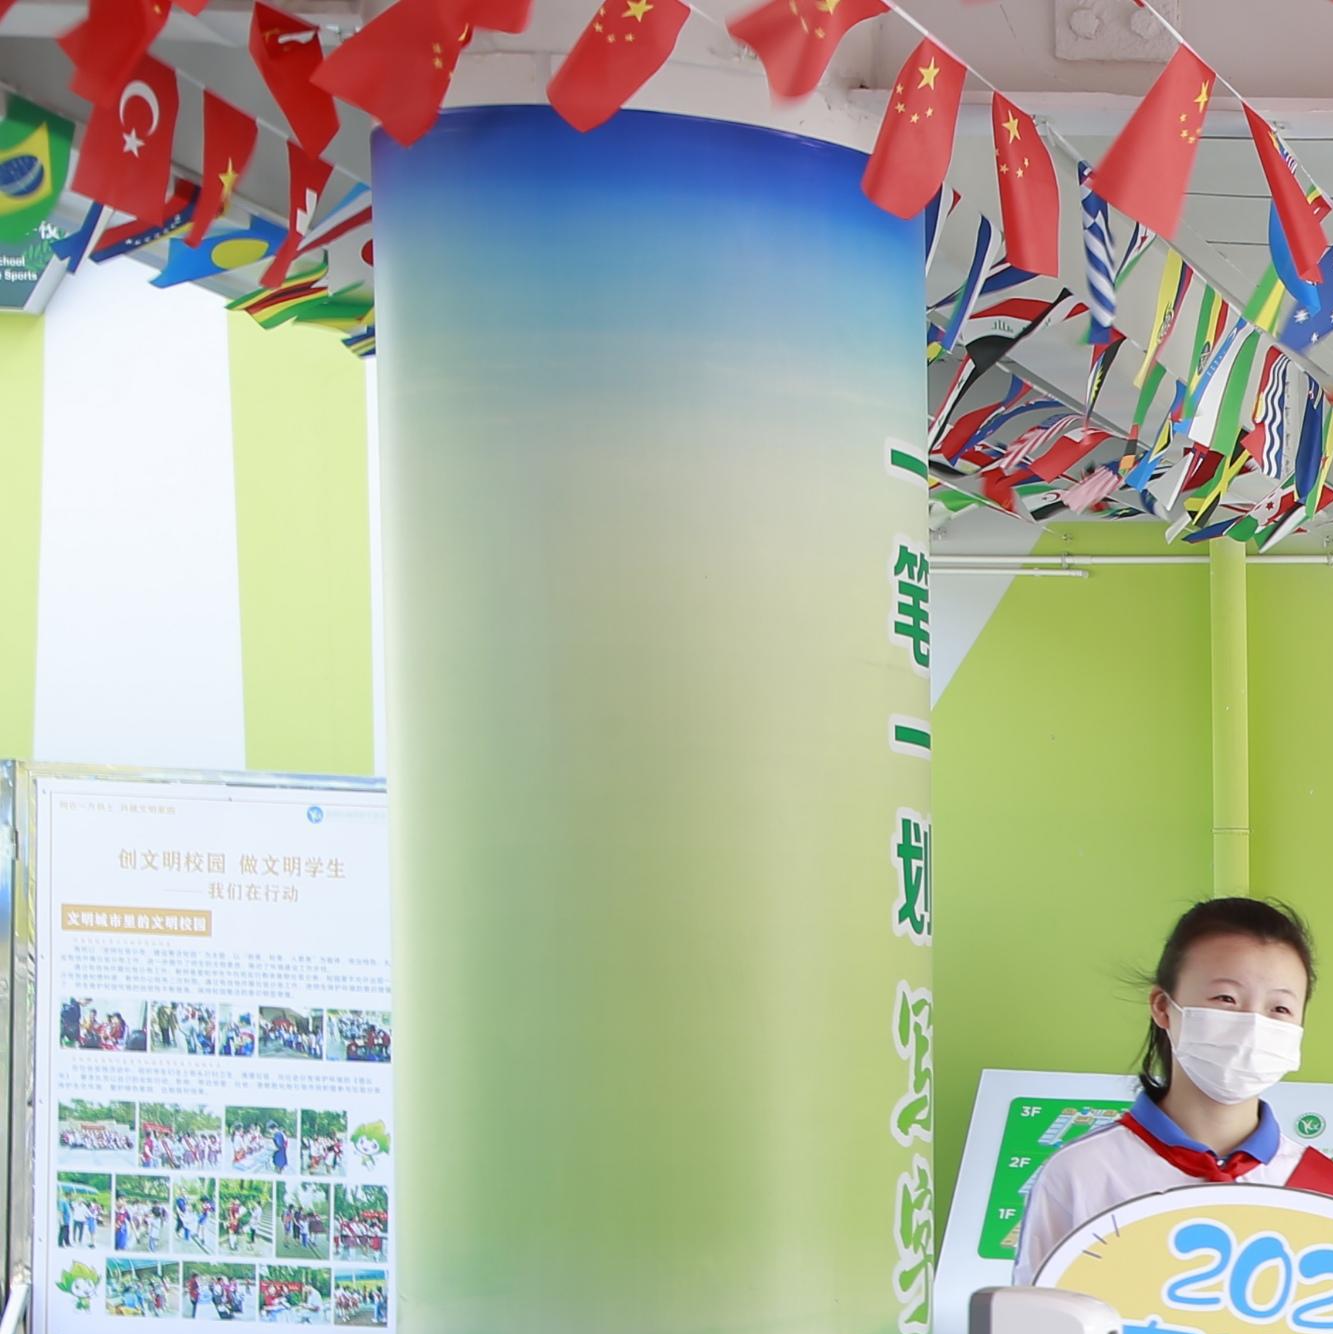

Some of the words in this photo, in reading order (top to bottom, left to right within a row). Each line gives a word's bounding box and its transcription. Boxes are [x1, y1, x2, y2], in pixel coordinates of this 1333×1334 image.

[118, 848, 226, 874] 创文明校园
[239, 854, 346, 879] 做文明学生
[207, 881, 299, 903] 我们在行动
[66, 910, 208, 933] 文明城市里的文明校园
[1021, 1106, 1042, 1117] 3F
[1009, 1157, 1031, 1168] 2F
[998, 1208, 1015, 1219] 1F
